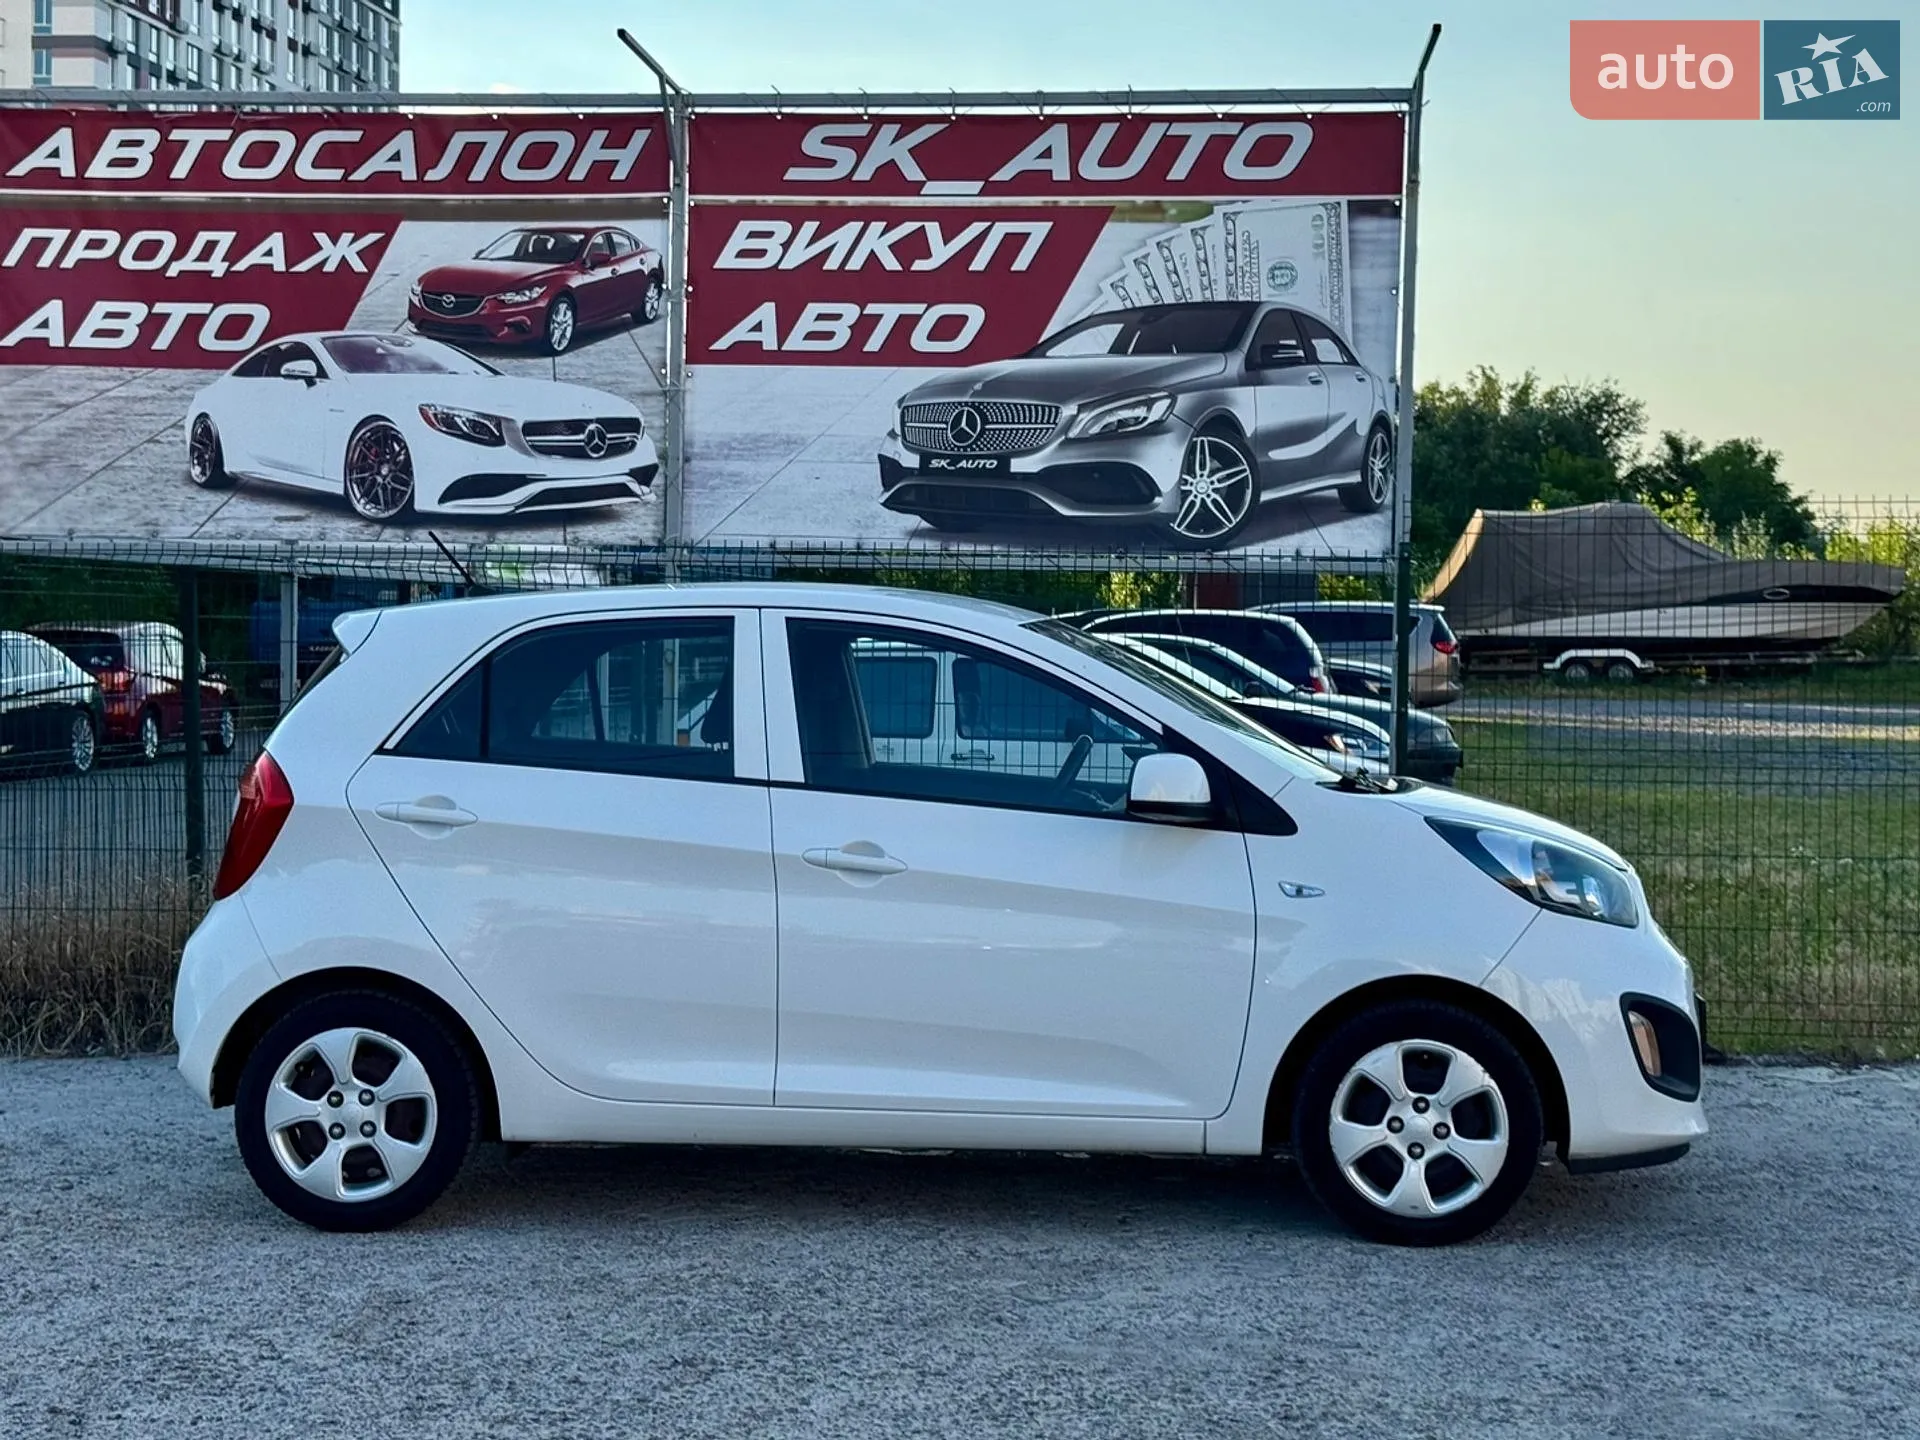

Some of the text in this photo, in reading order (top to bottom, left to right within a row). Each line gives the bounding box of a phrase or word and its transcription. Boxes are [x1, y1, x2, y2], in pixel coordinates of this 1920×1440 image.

[5, 128, 651, 183] АВТОСАЛОН
[782, 120, 1314, 195] SK_AUTO
[1, 228, 385, 278] ПРОДАЖ
[712, 220, 1053, 273] ВИКУП
[0, 300, 271, 352] АВТО
[710, 302, 985, 353] АВТО
[928, 457, 998, 470] SK_AUTO
